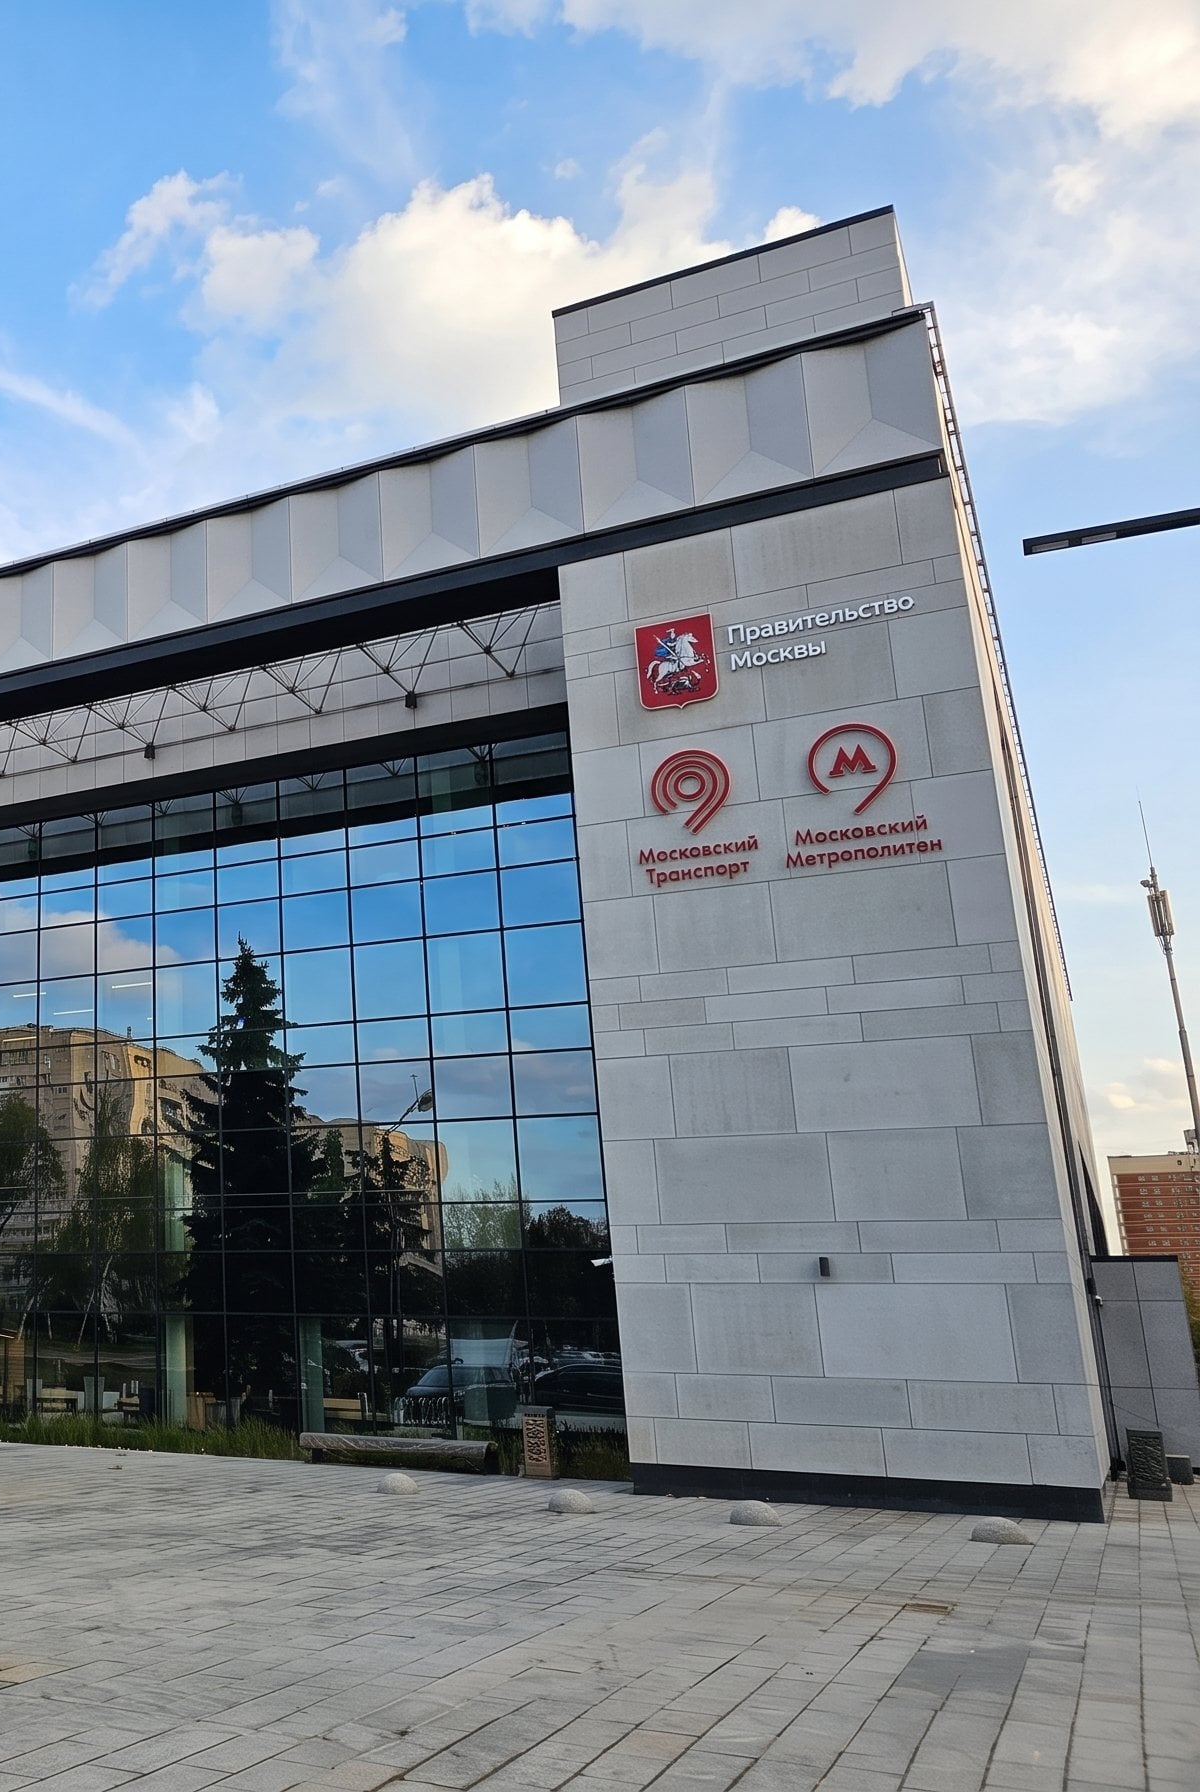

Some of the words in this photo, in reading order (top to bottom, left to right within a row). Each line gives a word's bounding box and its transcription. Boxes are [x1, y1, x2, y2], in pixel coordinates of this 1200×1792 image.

[727, 595, 914, 644] Правительство
[730, 640, 827, 671] Москвы
[827, 743, 877, 779] М
[795, 815, 928, 846] Московский
[639, 835, 757, 865] Московский
[786, 838, 942, 868] Метрополитен
[646, 860, 749, 887] Транспорт
